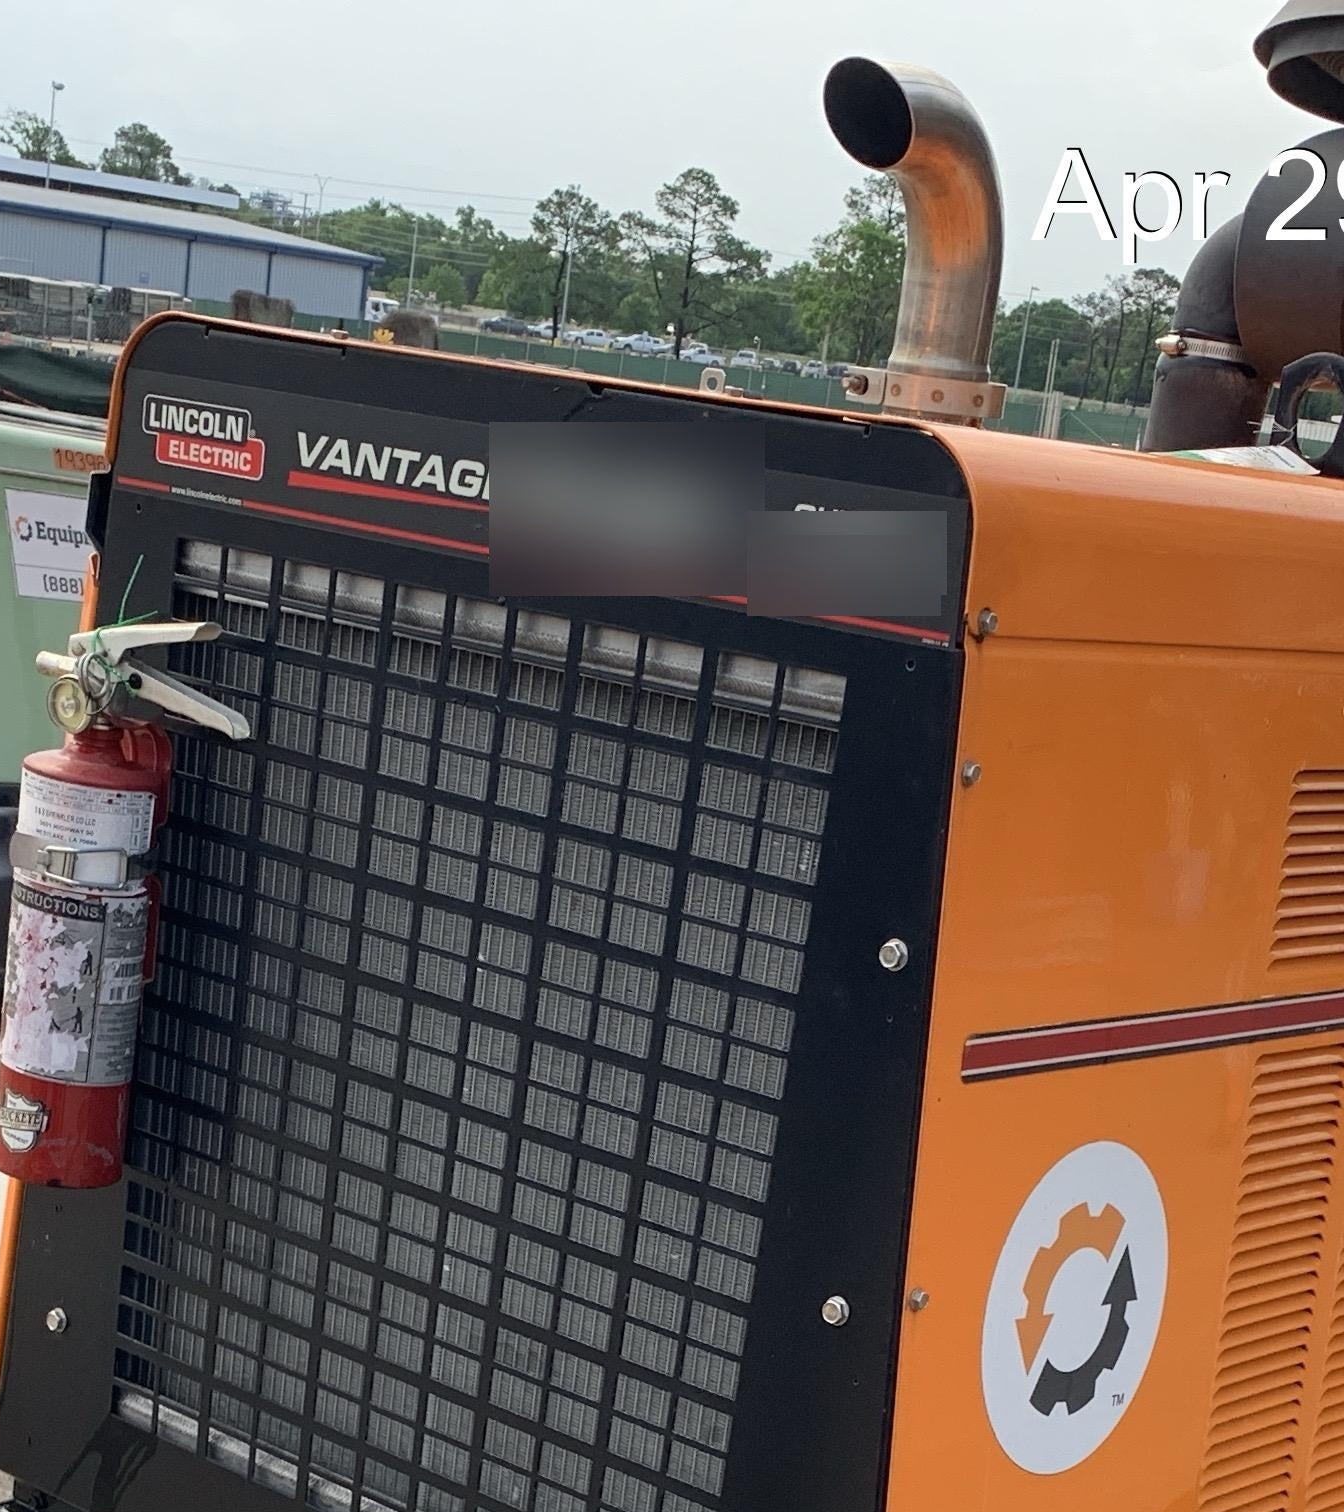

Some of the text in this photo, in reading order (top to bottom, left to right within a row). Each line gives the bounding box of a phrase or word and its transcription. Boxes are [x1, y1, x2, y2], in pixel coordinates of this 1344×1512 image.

[149, 402, 244, 442] LINCOLN
[55, 449, 107, 470] 19396
[168, 439, 253, 472] ELECTRIC
[296, 431, 489, 500] VANTAG
[171, 486, 242, 506] www.lincolnelectric.com
[12, 885, 99, 919] STRUCTIONS
[0, 1109, 41, 1125] BUCKEYE
